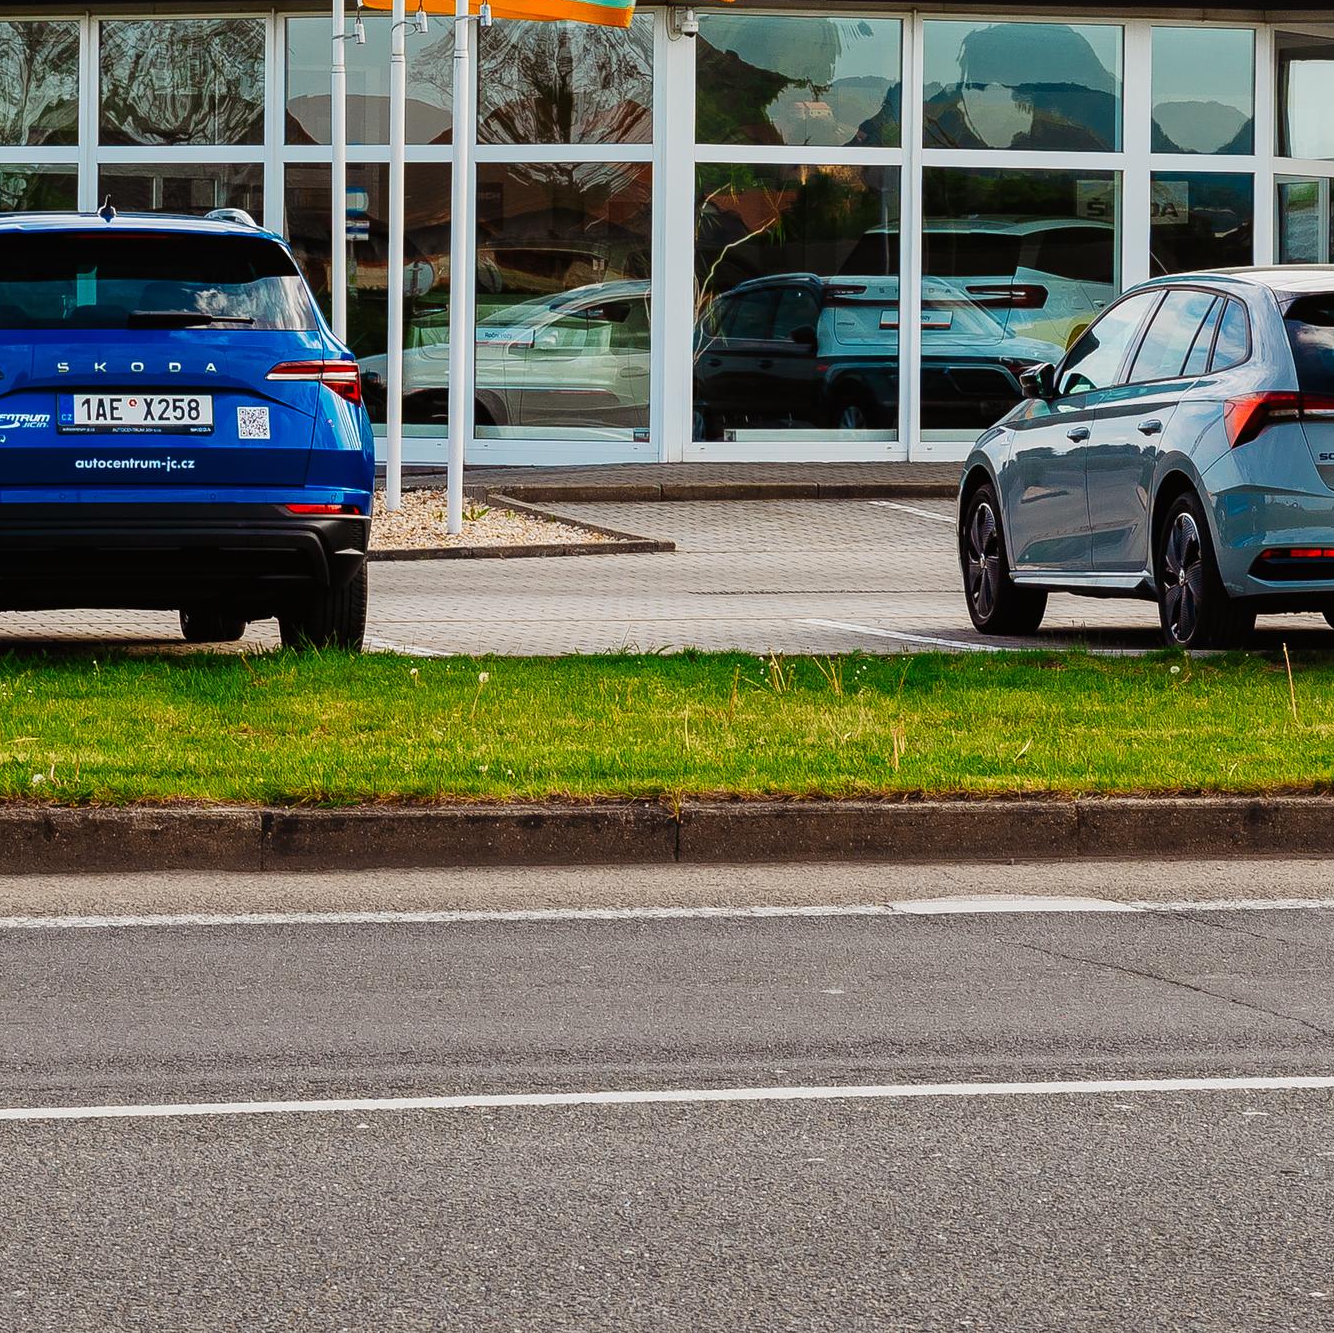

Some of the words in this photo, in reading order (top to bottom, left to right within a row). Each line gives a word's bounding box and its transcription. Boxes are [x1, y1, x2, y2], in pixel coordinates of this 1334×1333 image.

[57, 362, 217, 373] SKODA
[61, 413, 73, 421] CZ
[81, 398, 123, 421] 1AE
[143, 398, 201, 421] X258
[75, 456, 195, 472] autocentrum-jc.cz
